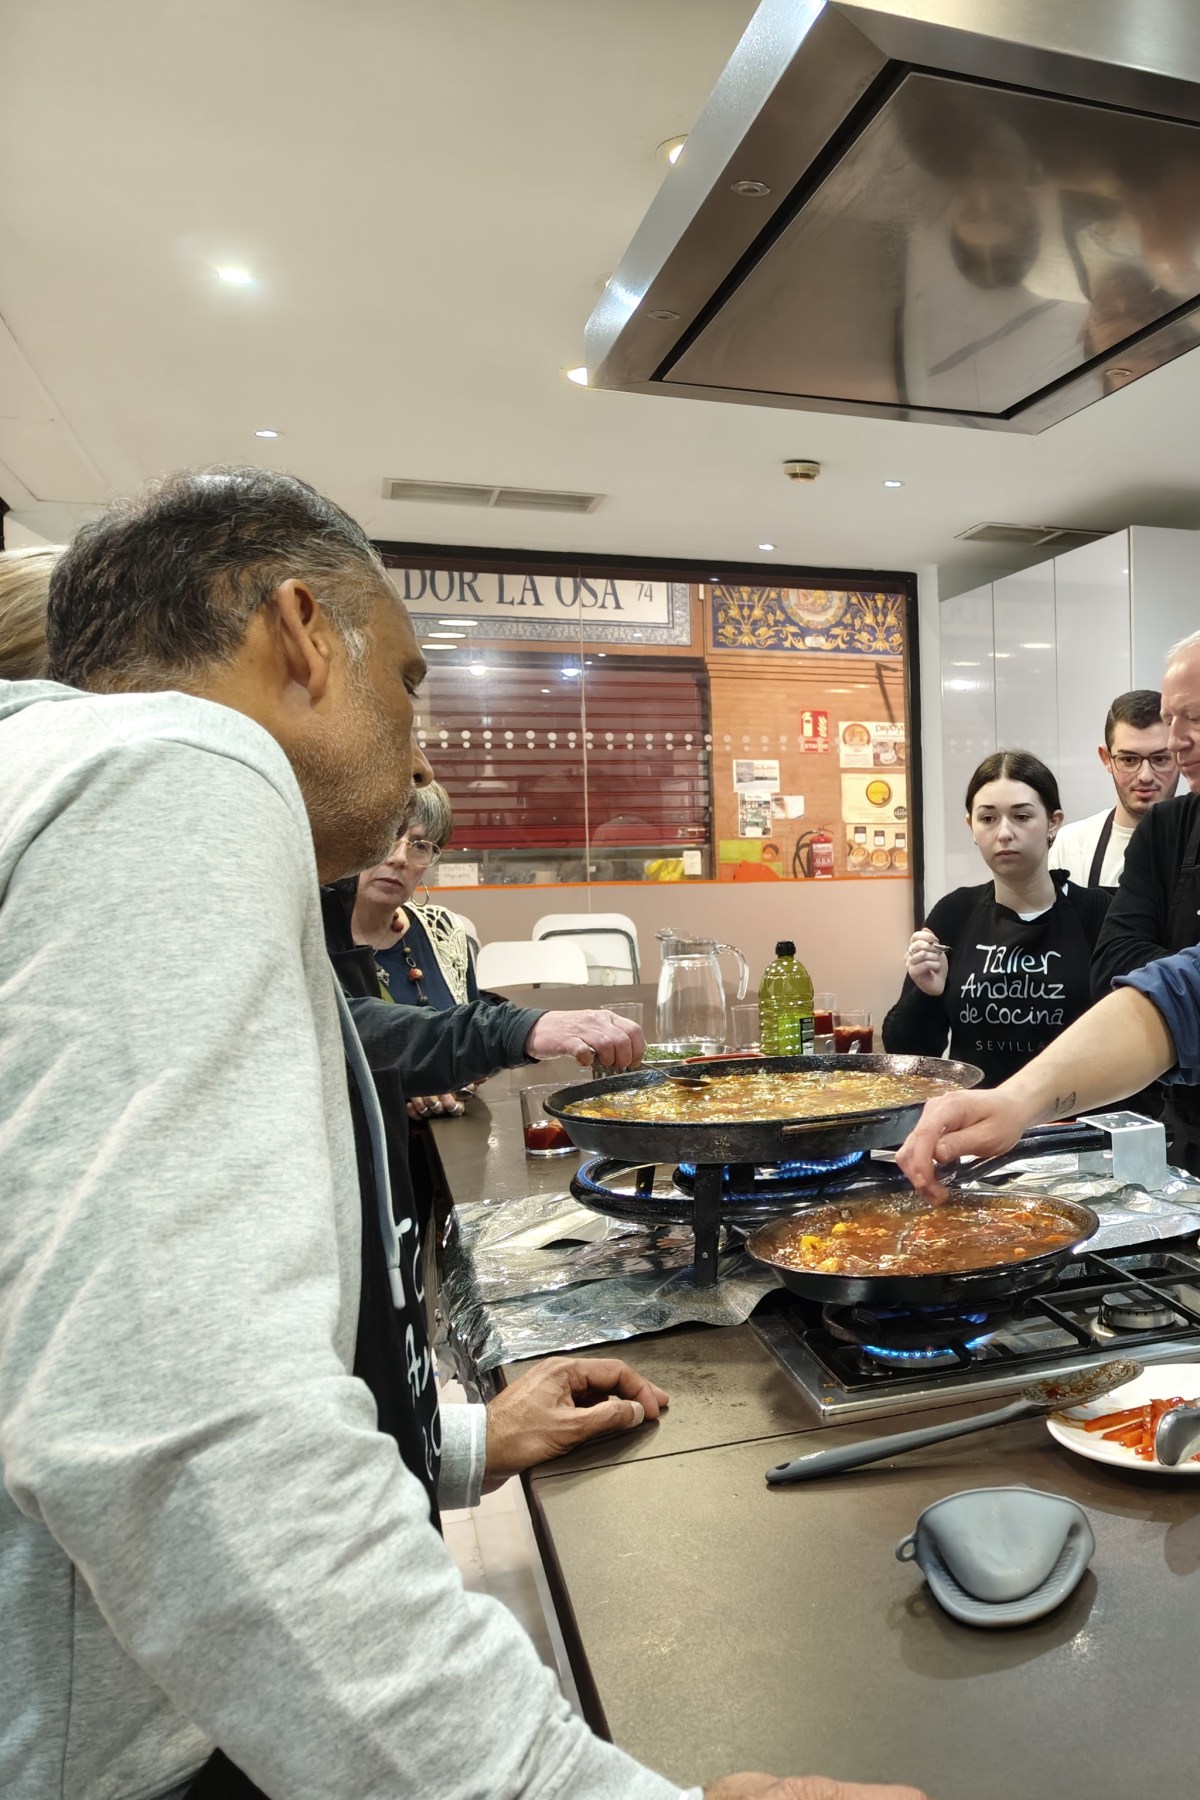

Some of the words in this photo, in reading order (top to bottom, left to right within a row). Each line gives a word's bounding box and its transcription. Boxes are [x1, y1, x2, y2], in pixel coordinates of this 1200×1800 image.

[496, 574, 544, 606] LA
[554, 576, 624, 610] OSA
[635, 583, 654, 602] 74
[975, 944, 1062, 975] Taller
[960, 973, 1066, 999] Andaluz
[960, 1003, 983, 1024] de
[985, 1003, 1064, 1026] Cocina
